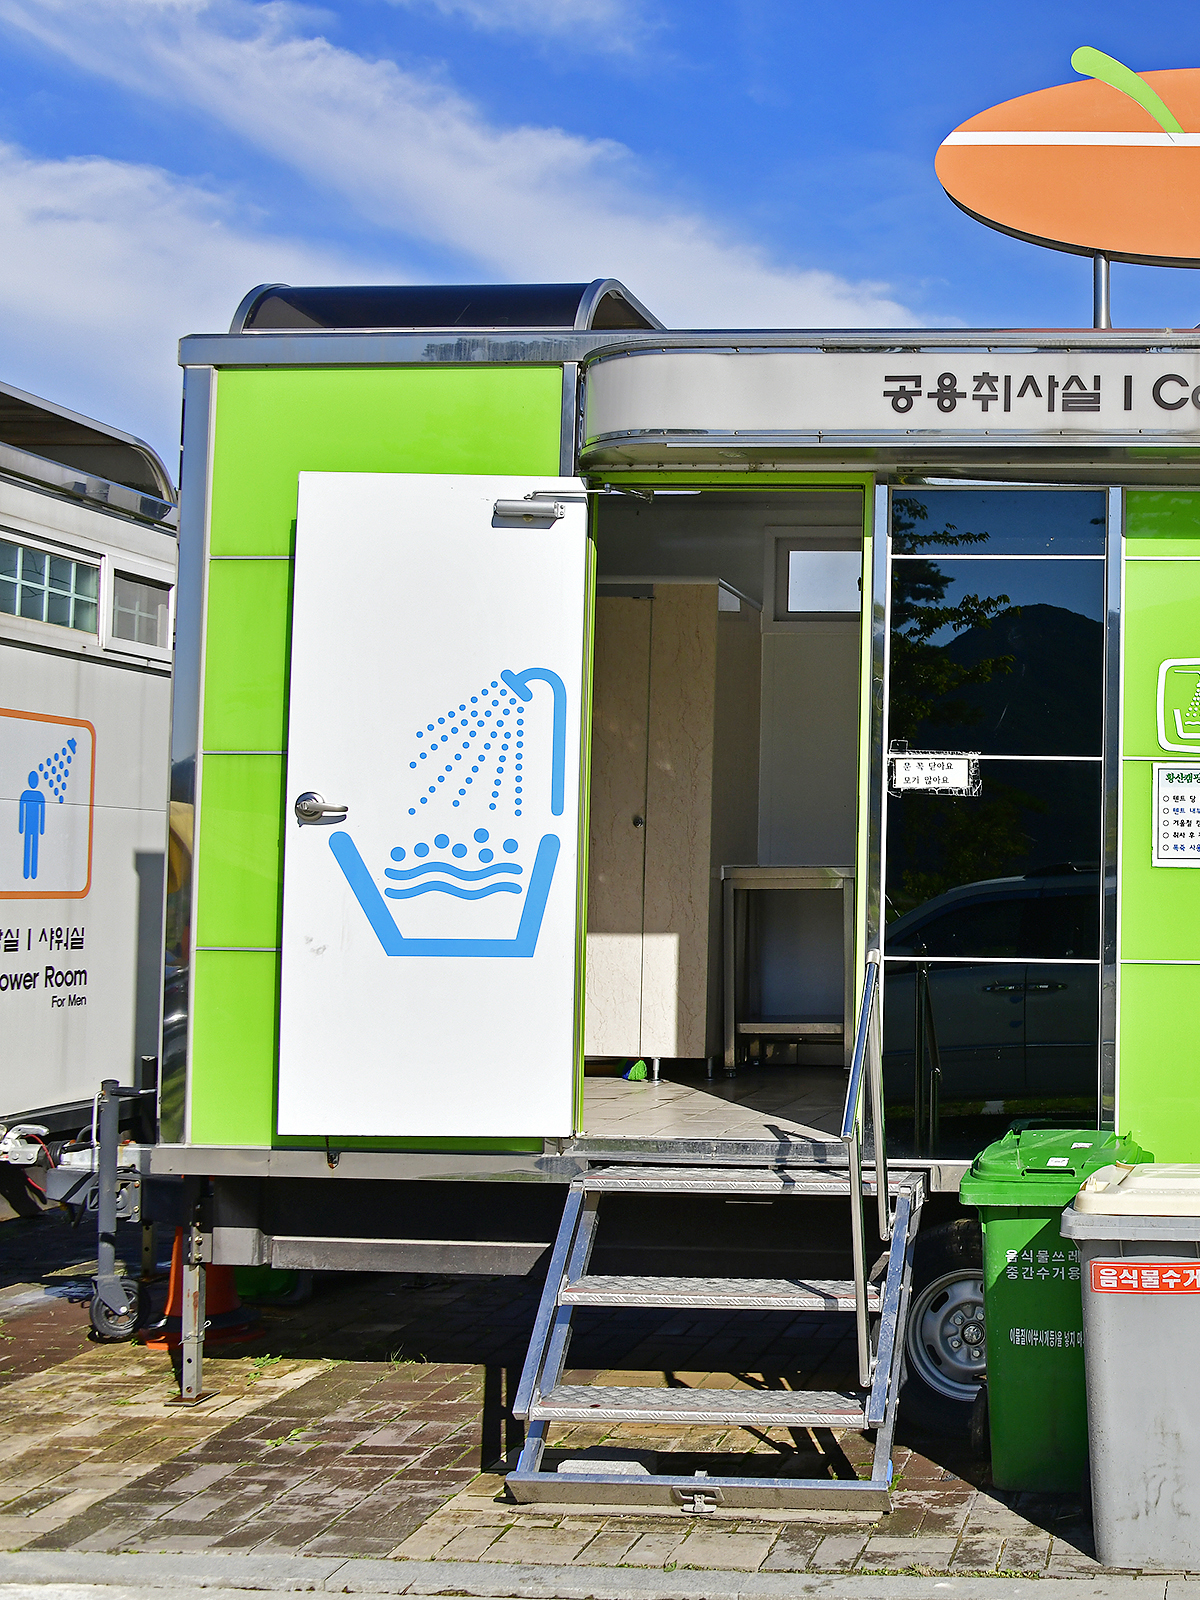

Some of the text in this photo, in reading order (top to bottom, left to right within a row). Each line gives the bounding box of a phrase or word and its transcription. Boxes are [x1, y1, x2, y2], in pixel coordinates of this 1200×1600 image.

[883, 371, 1101, 414] 공용취사실
[38, 926, 85, 951] 샤워실
[44, 965, 88, 988] Room
[51, 993, 87, 1008] For Men
